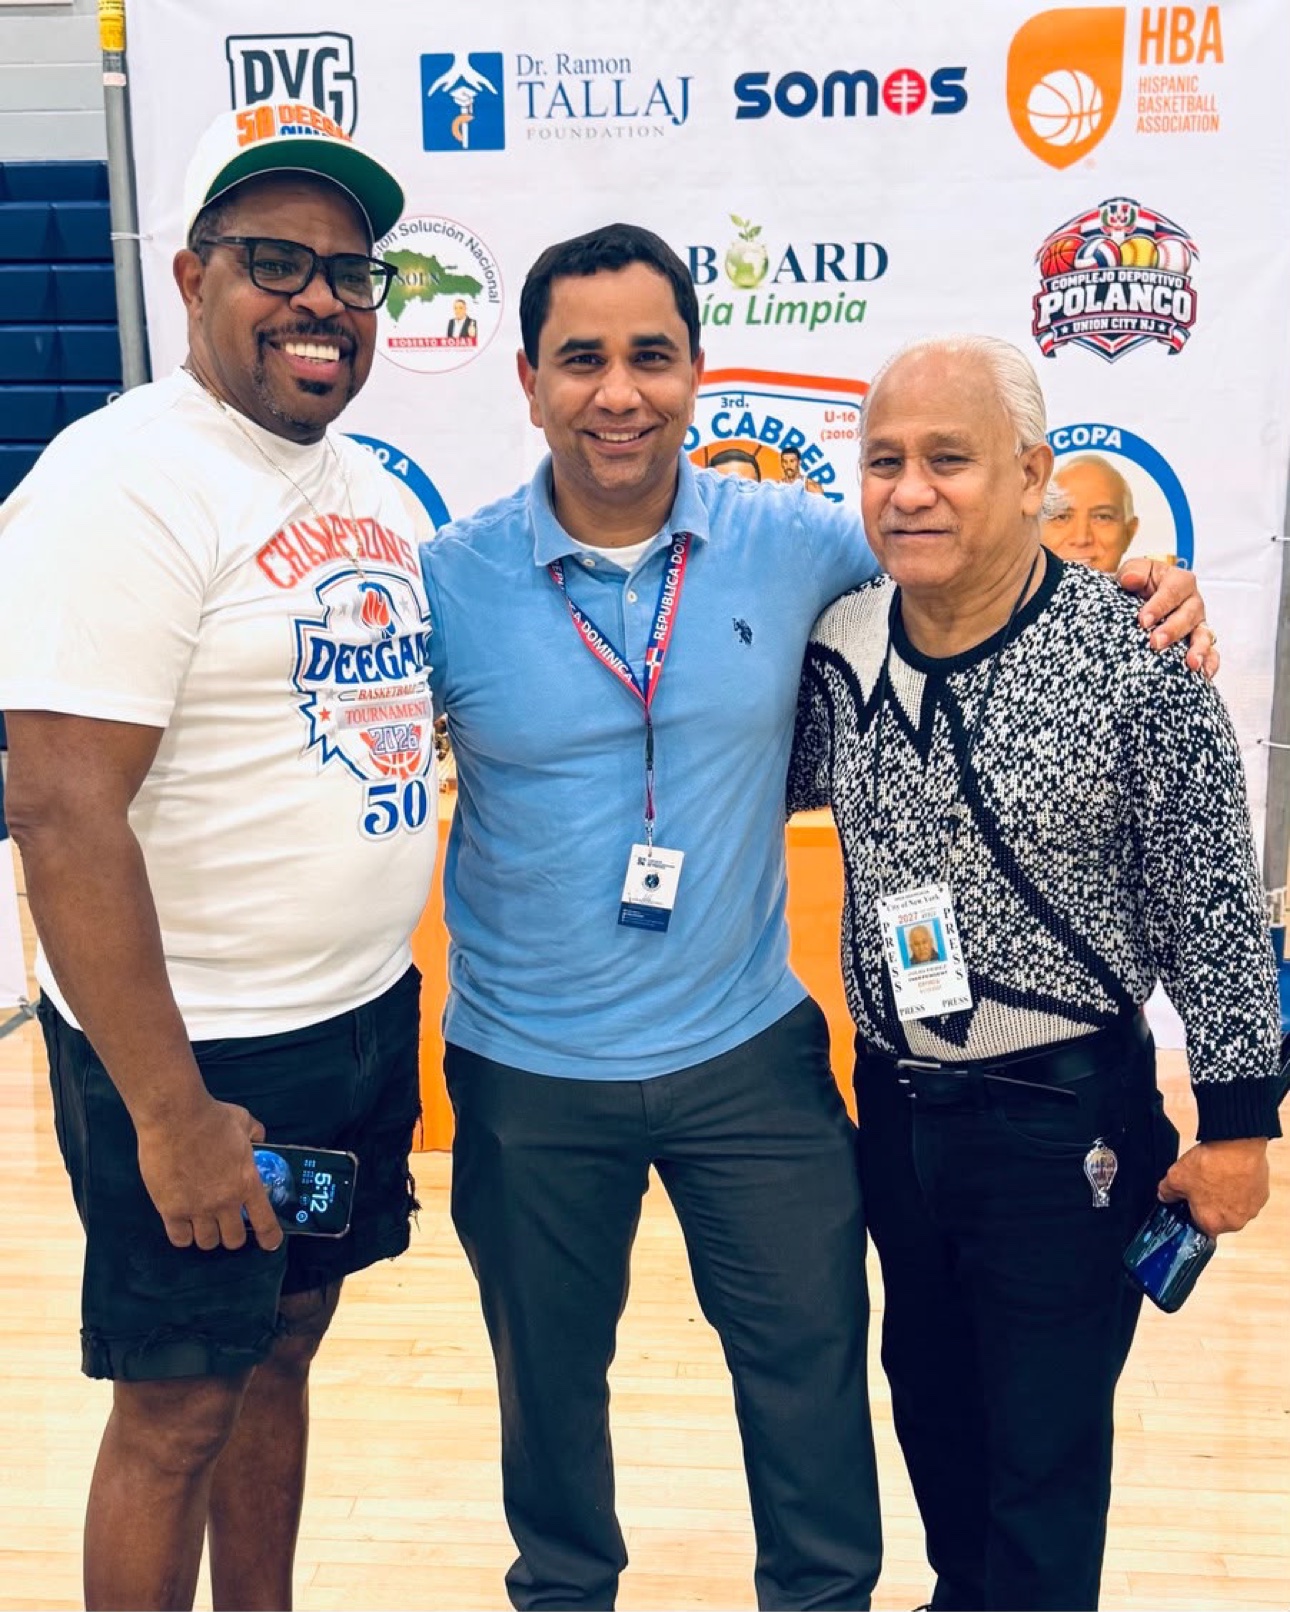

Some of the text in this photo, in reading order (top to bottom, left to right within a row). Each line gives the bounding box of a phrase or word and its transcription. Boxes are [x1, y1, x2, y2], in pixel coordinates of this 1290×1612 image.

[1138, 6, 1224, 66] HBA
[516, 53, 632, 77] Dr. Ramon
[1138, 76, 1199, 94] HISPANIC
[517, 76, 694, 126] TALLAJ
[1137, 95, 1218, 114] BASKETBALL
[236, 105, 276, 148] 50
[526, 125, 665, 140] FOUNDATION
[1136, 115, 1220, 134] ASSOCIATION
[399, 220, 465, 243] Solución
[465, 236, 500, 304] Nacional
[1051, 271, 1184, 291] COMPLEJO DEPORTIVO
[746, 292, 868, 332] Limpia
[1037, 282, 1192, 329] POLANCO
[1073, 317, 1155, 333] UNION CITY NJ
[391, 338, 474, 347] ROBERTO ROJAS
[720, 394, 750, 409] 3rd.
[824, 411, 856, 423] U-16
[820, 429, 860, 442] (2010)
[1053, 426, 1122, 449] COPA
[256, 512, 419, 589] CHAMPIONS
[653, 567, 681, 641] REPUBLICA
[345, 700, 427, 725] TOURNAMENT
[368, 722, 419, 755] 2026
[364, 780, 428, 835] 50
[309, 1172, 332, 1214] 5:12
